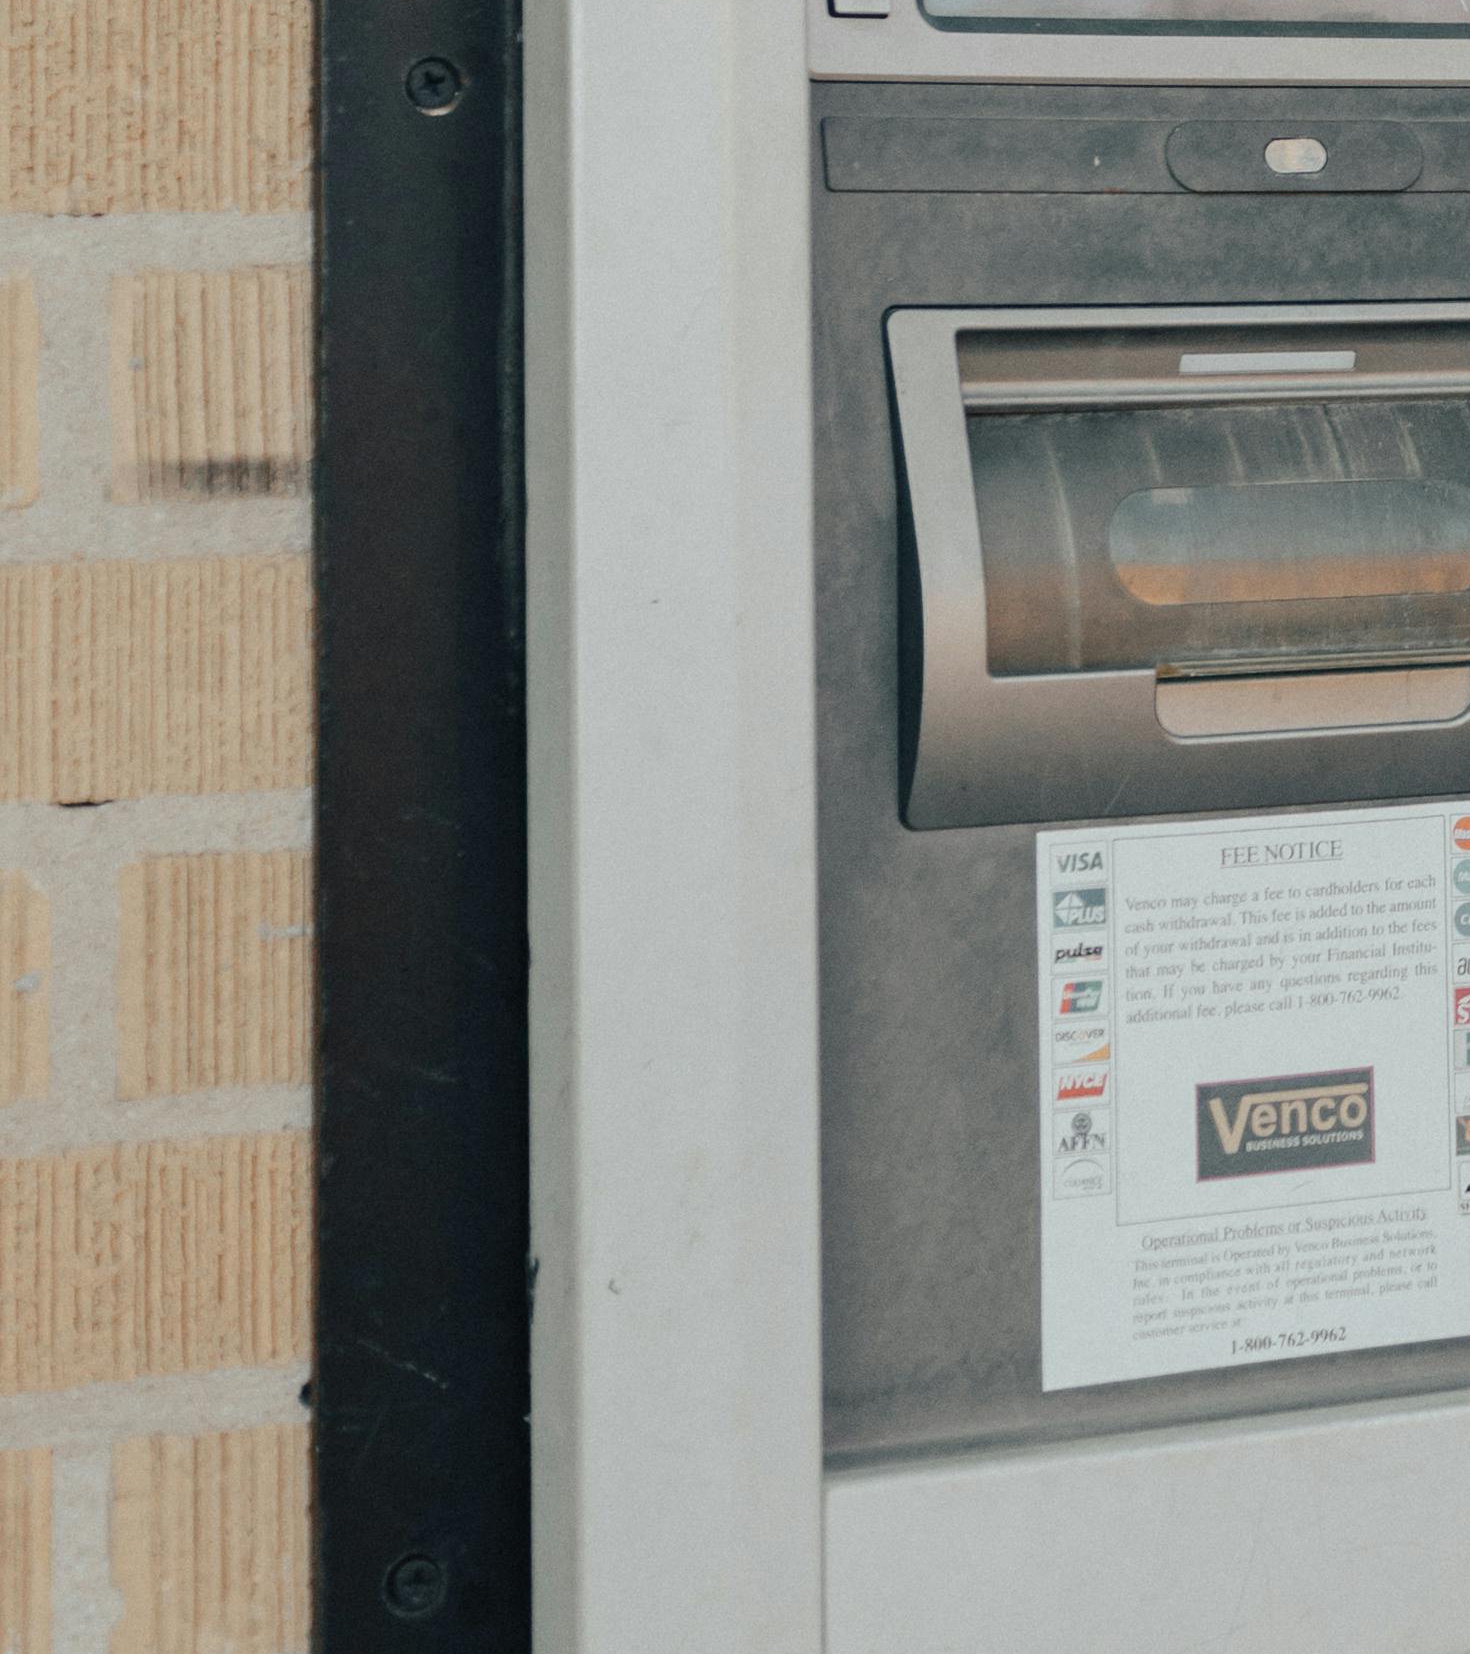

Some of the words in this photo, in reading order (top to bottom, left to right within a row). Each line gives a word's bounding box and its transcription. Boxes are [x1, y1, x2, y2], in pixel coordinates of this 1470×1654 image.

[1057, 851, 1104, 873] VISA
[1221, 846, 1259, 865] FEE
[1264, 840, 1343, 863] NOTICE
[1125, 897, 1167, 911] Venco
[1171, 897, 1198, 910] may
[1203, 891, 1247, 908] charge
[1264, 887, 1284, 901] fee
[1305, 880, 1380, 897] cardholders
[1385, 877, 1403, 891] for
[1407, 874, 1436, 889] each
[1125, 919, 1154, 934] cash
[1239, 910, 1267, 925] This
[1271, 908, 1292, 922] fee
[1310, 903, 1348, 920] added
[1367, 901, 1386, 914] the
[1390, 898, 1437, 912] amount
[1054, 942, 1104, 963] pulse
[1144, 943, 1174, 959] your
[1179, 934, 1251, 951] withdrawal
[1256, 931, 1279, 946] and
[1315, 927, 1367, 941] addition
[1388, 921, 1407, 934] the
[1411, 918, 1437, 932] fees
[1125, 965, 1151, 979] that
[1156, 964, 1185, 979] may
[1212, 955, 1264, 973] charged
[1292, 952, 1321, 970] your
[1327, 944, 1386, 962] Financial
[1181, 985, 1205, 1001] you
[1212, 980, 1243, 995] have
[1249, 979, 1272, 993] any
[1280, 973, 1342, 992] questions
[1347, 965, 1408, 985] regarding
[1415, 961, 1438, 976] this
[1126, 1003, 1192, 1023] additional
[1225, 1000, 1264, 1019] please
[1269, 995, 1292, 1011] call
[1055, 1027, 1105, 1043] DISCOVER
[1060, 1073, 1106, 1094] NYCE
[1208, 1083, 1369, 1155] Venco
[1058, 1132, 1106, 1153] AFFN
[1246, 1135, 1300, 1152] BUSINESS
[1302, 1129, 1364, 1147] SOLUTIONS
[1142, 1228, 1219, 1251] Operational
[1223, 1223, 1284, 1241] Problems
[1305, 1215, 1374, 1232] Suspicious
[1231, 1326, 1347, 1355] 1-800-762-9962
